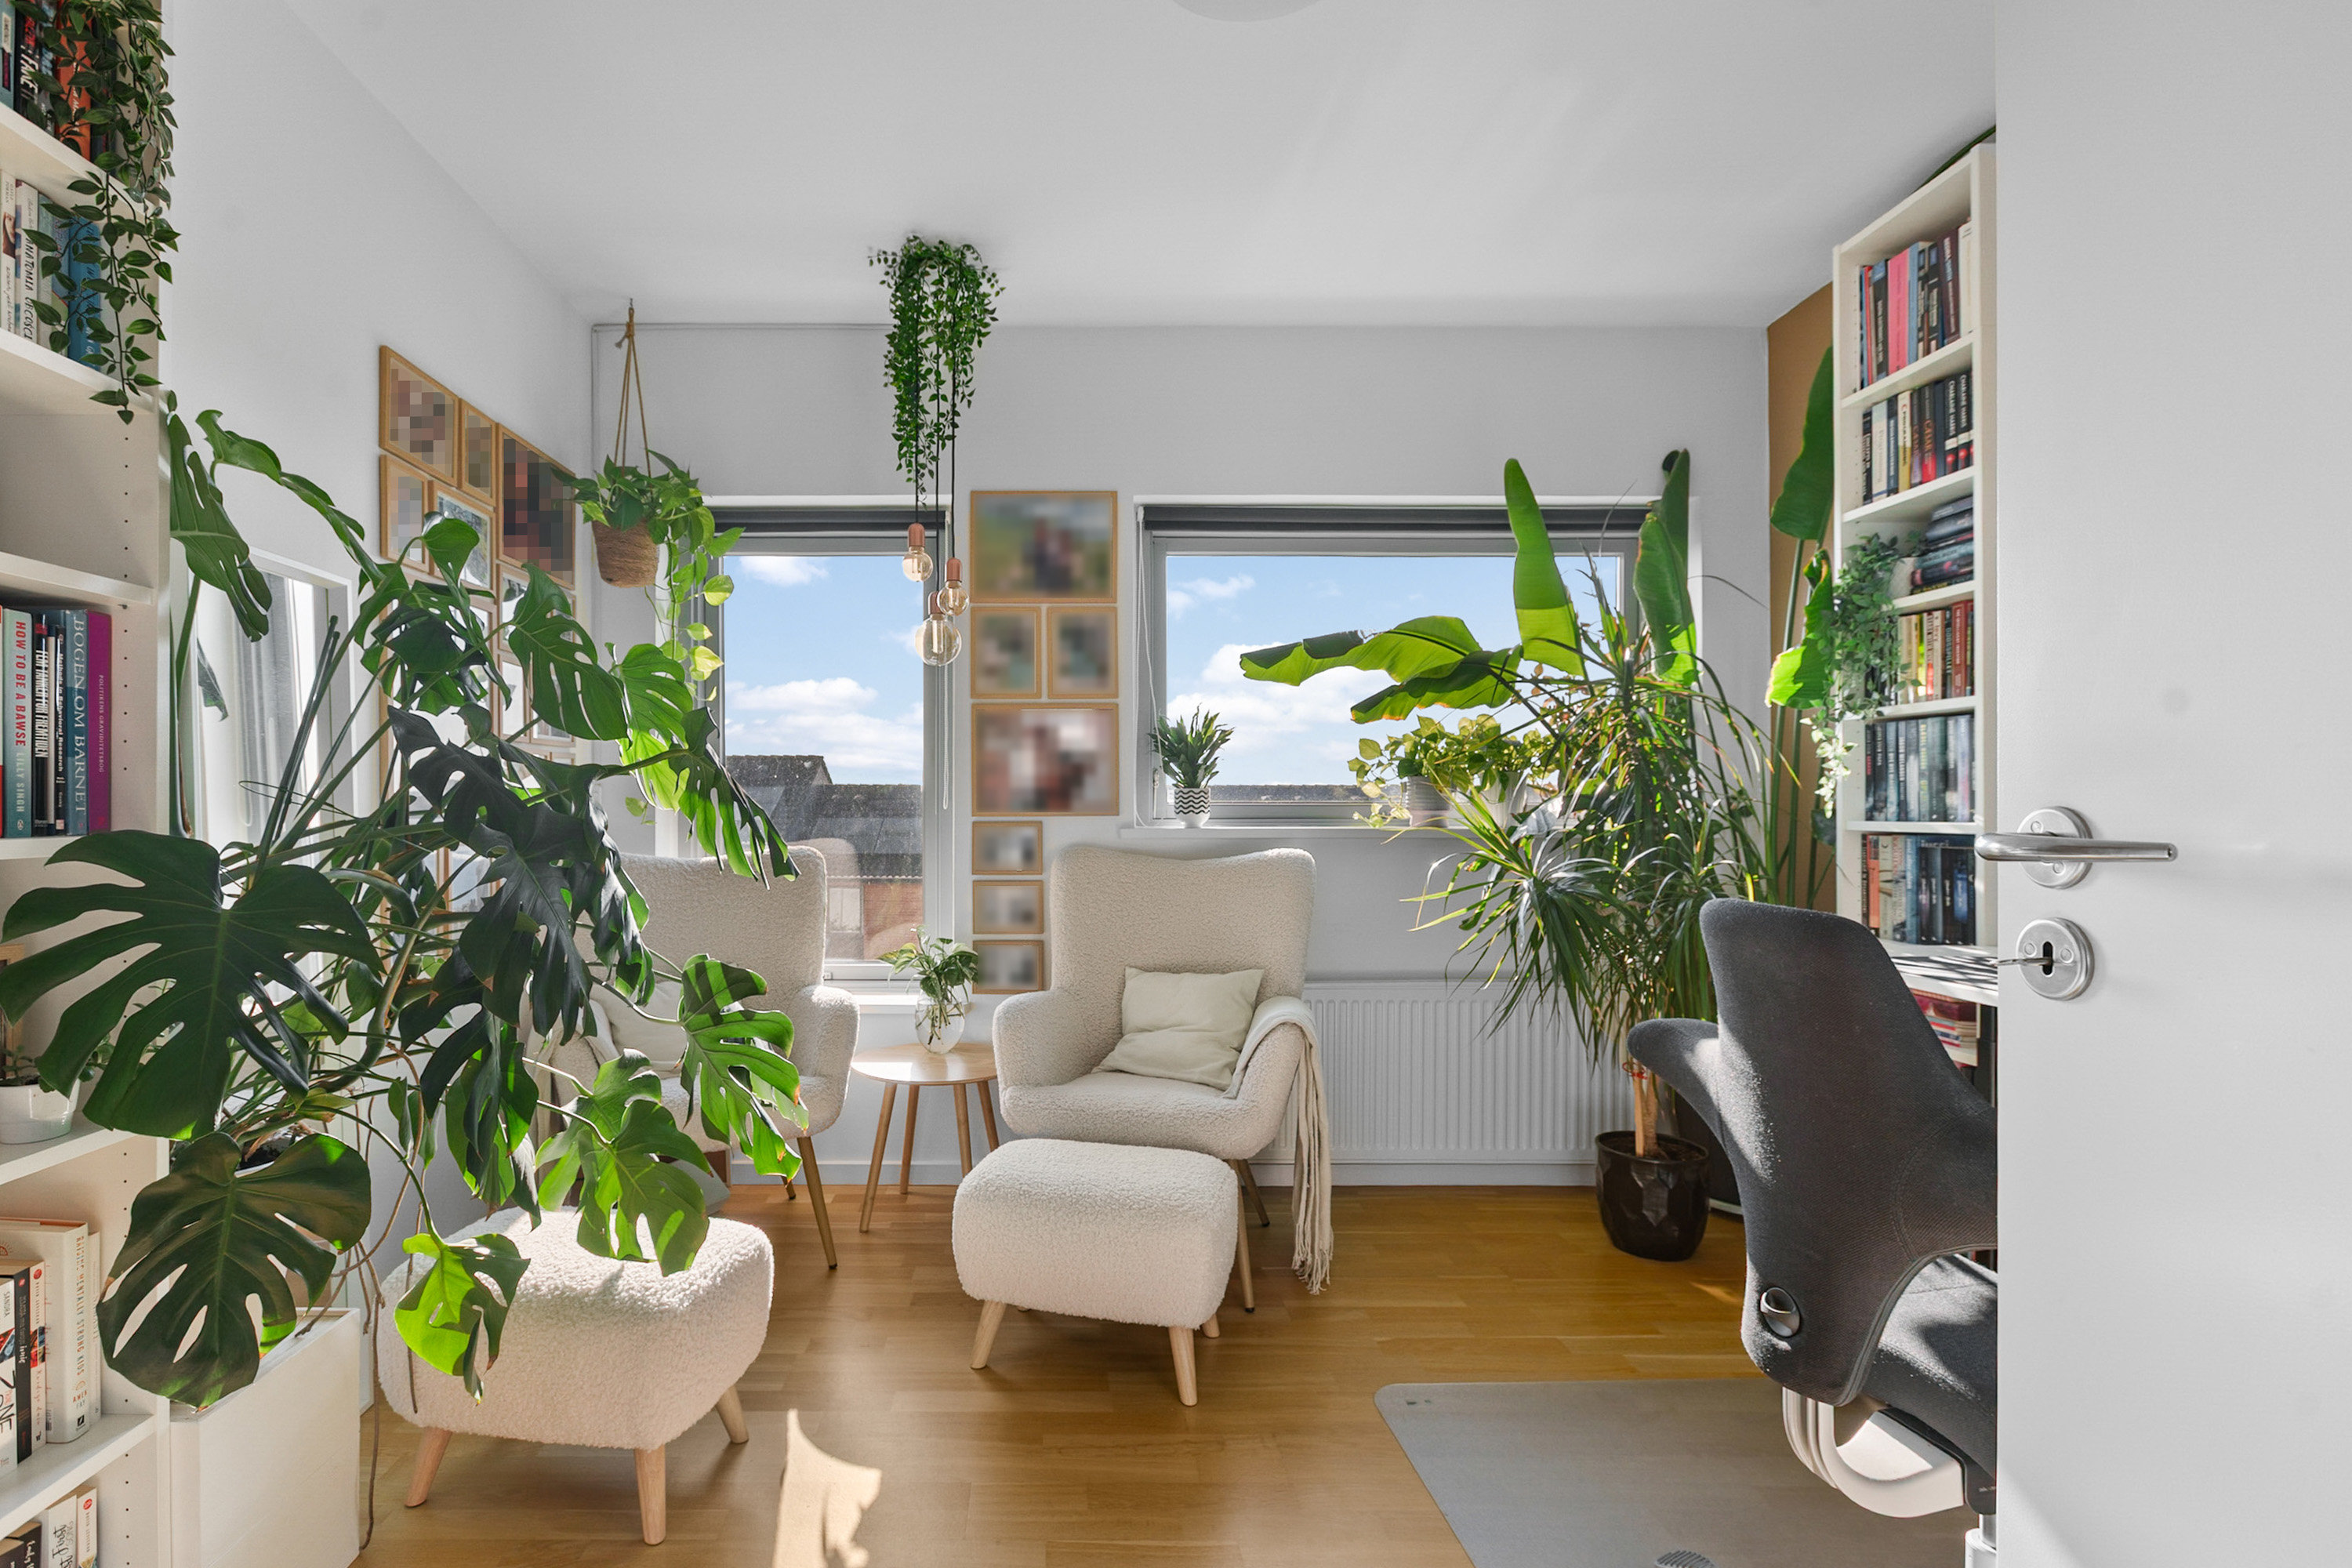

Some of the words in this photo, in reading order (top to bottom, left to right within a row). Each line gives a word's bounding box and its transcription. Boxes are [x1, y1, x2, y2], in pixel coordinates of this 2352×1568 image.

[25, 238, 34, 291] ANATOMIA
[24, 297, 35, 340] OBCOŚCI
[16, 621, 26, 649] HOW
[16, 655, 26, 669] TO
[74, 619, 85, 689] BOGEN
[16, 673, 26, 688] BE
[16, 705, 26, 746] BAWSE
[74, 695, 85, 728] OM
[35, 714, 49, 758] FREMTIDEN
[16, 753, 25, 780] LILLY
[74, 735, 86, 815] BARNET
[16, 782, 25, 812] SINGH
[52, 1524, 69, 1559] First
